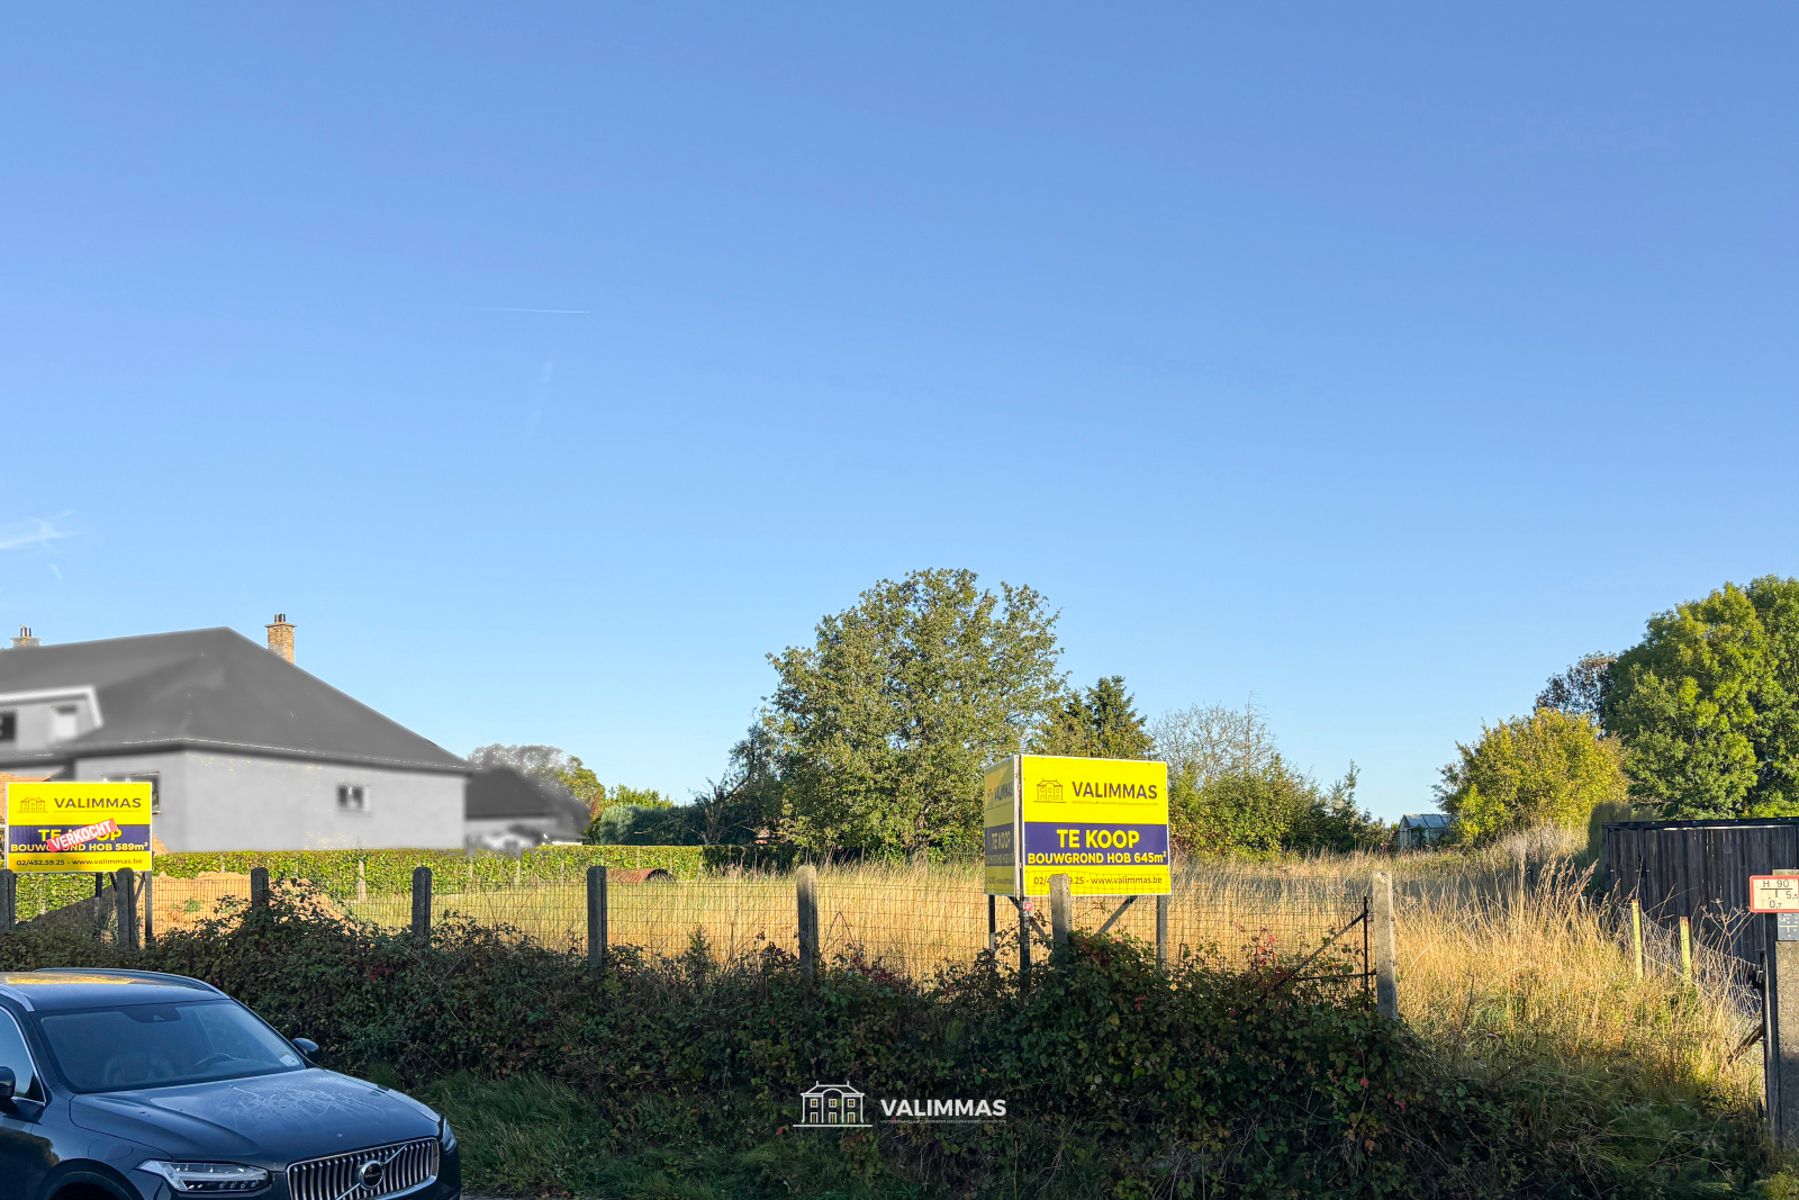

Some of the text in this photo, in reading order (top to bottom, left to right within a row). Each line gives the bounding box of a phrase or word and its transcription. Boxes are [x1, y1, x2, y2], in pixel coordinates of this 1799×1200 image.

[1072, 781, 1158, 800] VALIMMAS
[54, 797, 142, 809] VALIMMAS
[51, 819, 112, 850] VERKOCHT
[1056, 829, 1140, 849] TE KOOP
[10, 843, 86, 852] BOUWOND
[89, 843, 113, 852] HOB
[72, 857, 143, 866] www.valimmas.be
[1028, 852, 1104, 865] BOUWGROND
[1108, 853, 1132, 865] HOB
[1134, 851, 1167, 864] 645m²
[1091, 876, 1162, 885] www.valimmas.be
[1763, 880, 1790, 888] H 90
